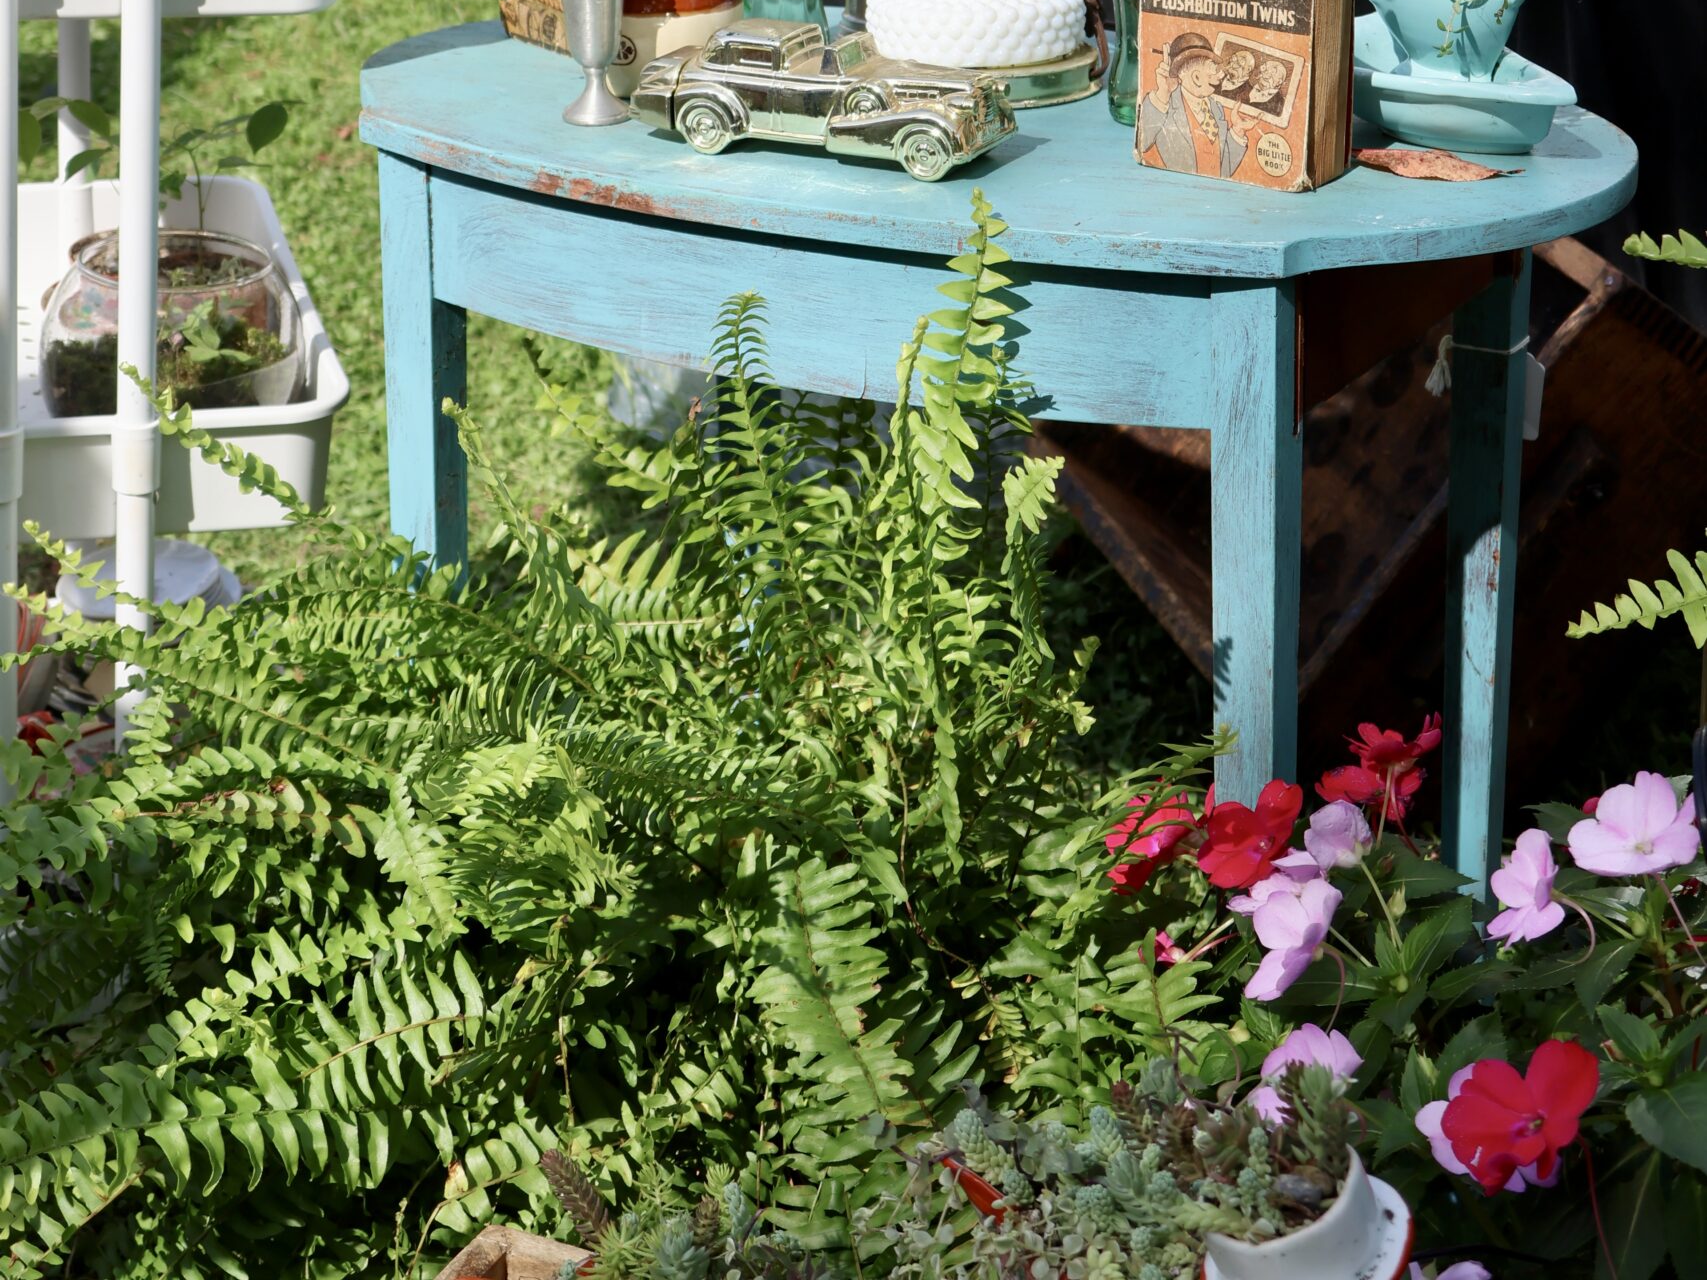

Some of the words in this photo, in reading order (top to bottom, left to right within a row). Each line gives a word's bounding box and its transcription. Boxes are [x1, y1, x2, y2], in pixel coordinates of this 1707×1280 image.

[1250, 1, 1296, 27] TWINS
[1268, 141, 1280, 149] THE
[1258, 148, 1270, 157] BIG
